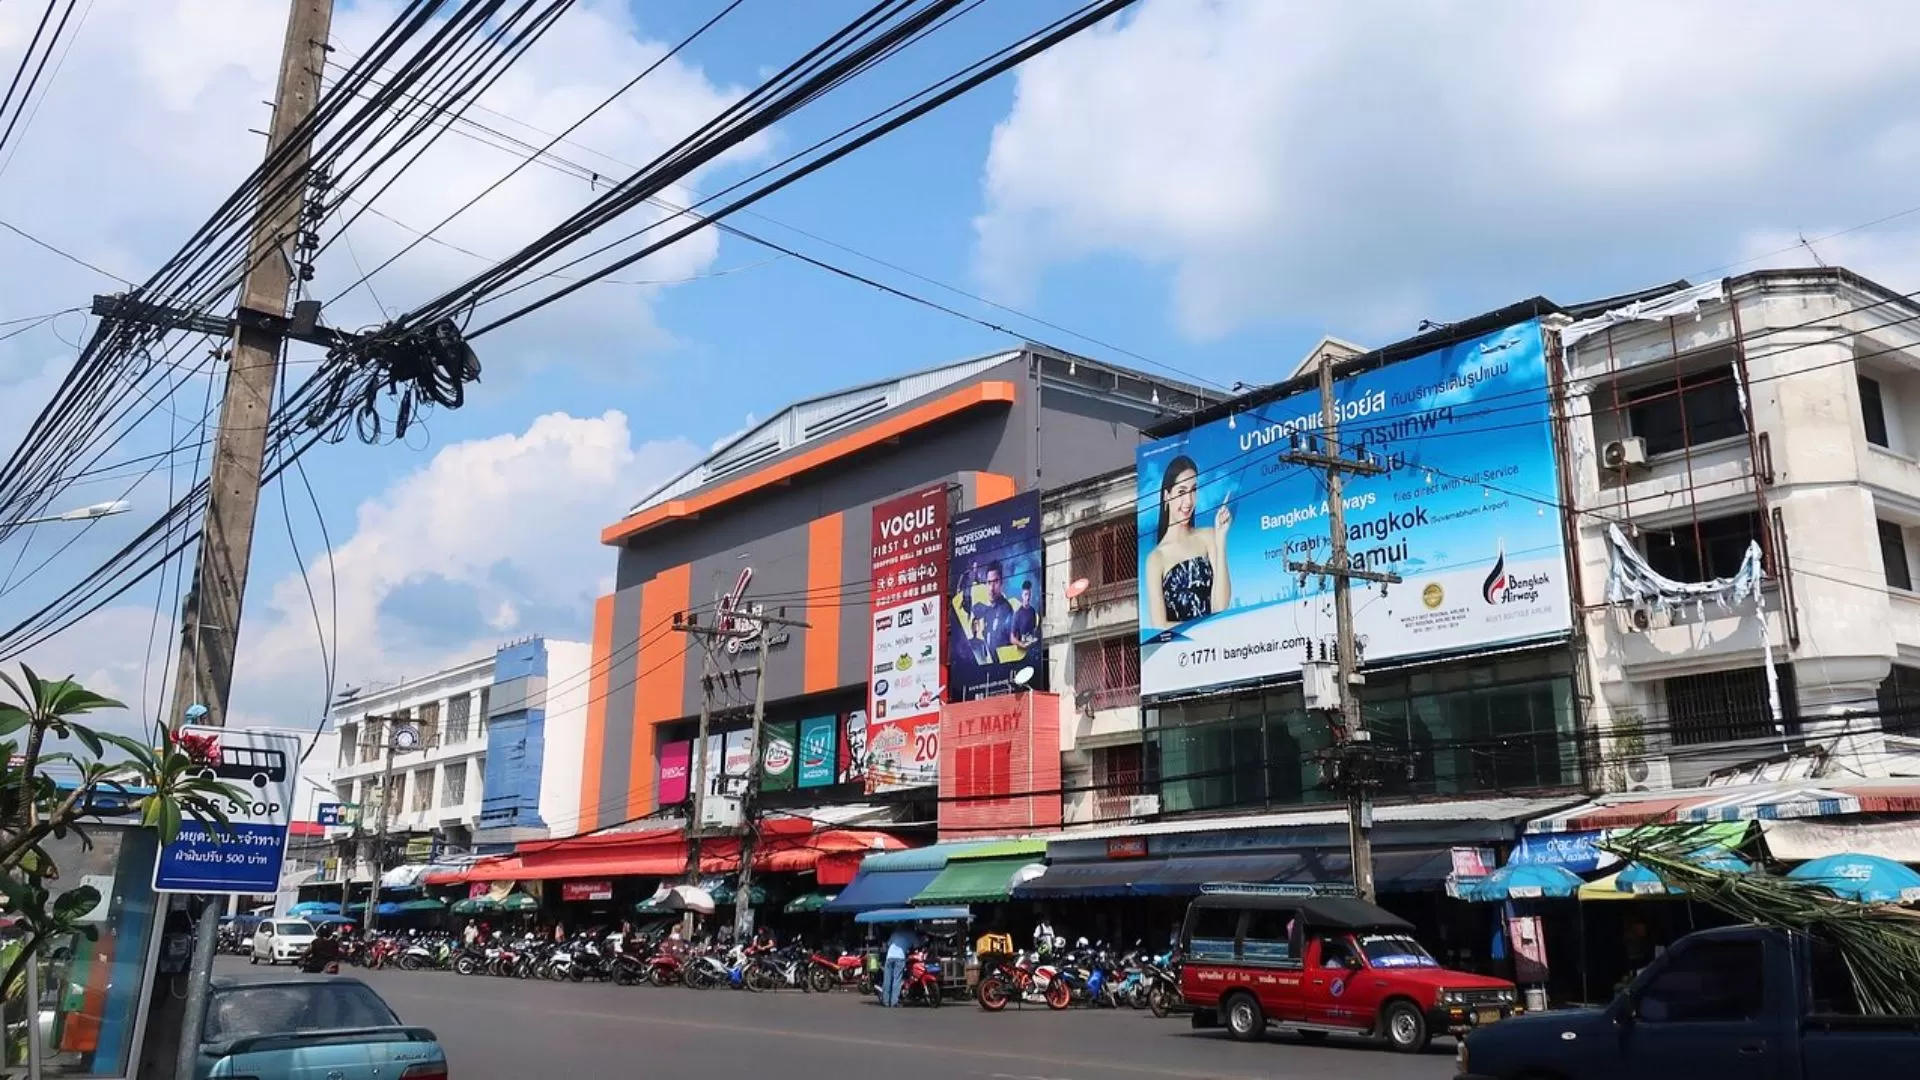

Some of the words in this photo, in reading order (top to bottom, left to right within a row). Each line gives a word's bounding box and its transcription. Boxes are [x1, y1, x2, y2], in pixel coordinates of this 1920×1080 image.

[1261, 504, 1317, 530] Bangkok
[1320, 491, 1376, 516] Aways
[1413, 482, 1439, 498] direct
[1441, 478, 1461, 491] with
[1462, 464, 1520, 486] Full-Service
[880, 505, 936, 540] VOGUE
[873, 540, 899, 558] FIRST
[913, 527, 942, 546] ONLY
[954, 524, 1002, 546] PROFESSIONAL
[954, 543, 977, 557] FUTSAL
[1508, 572, 1550, 591] Bangkok
[1501, 589, 1539, 604] Airways
[1191, 648, 1216, 664] 1771
[1223, 637, 1305, 660] bangkokair.com
[225, 853, 245, 864] 500
